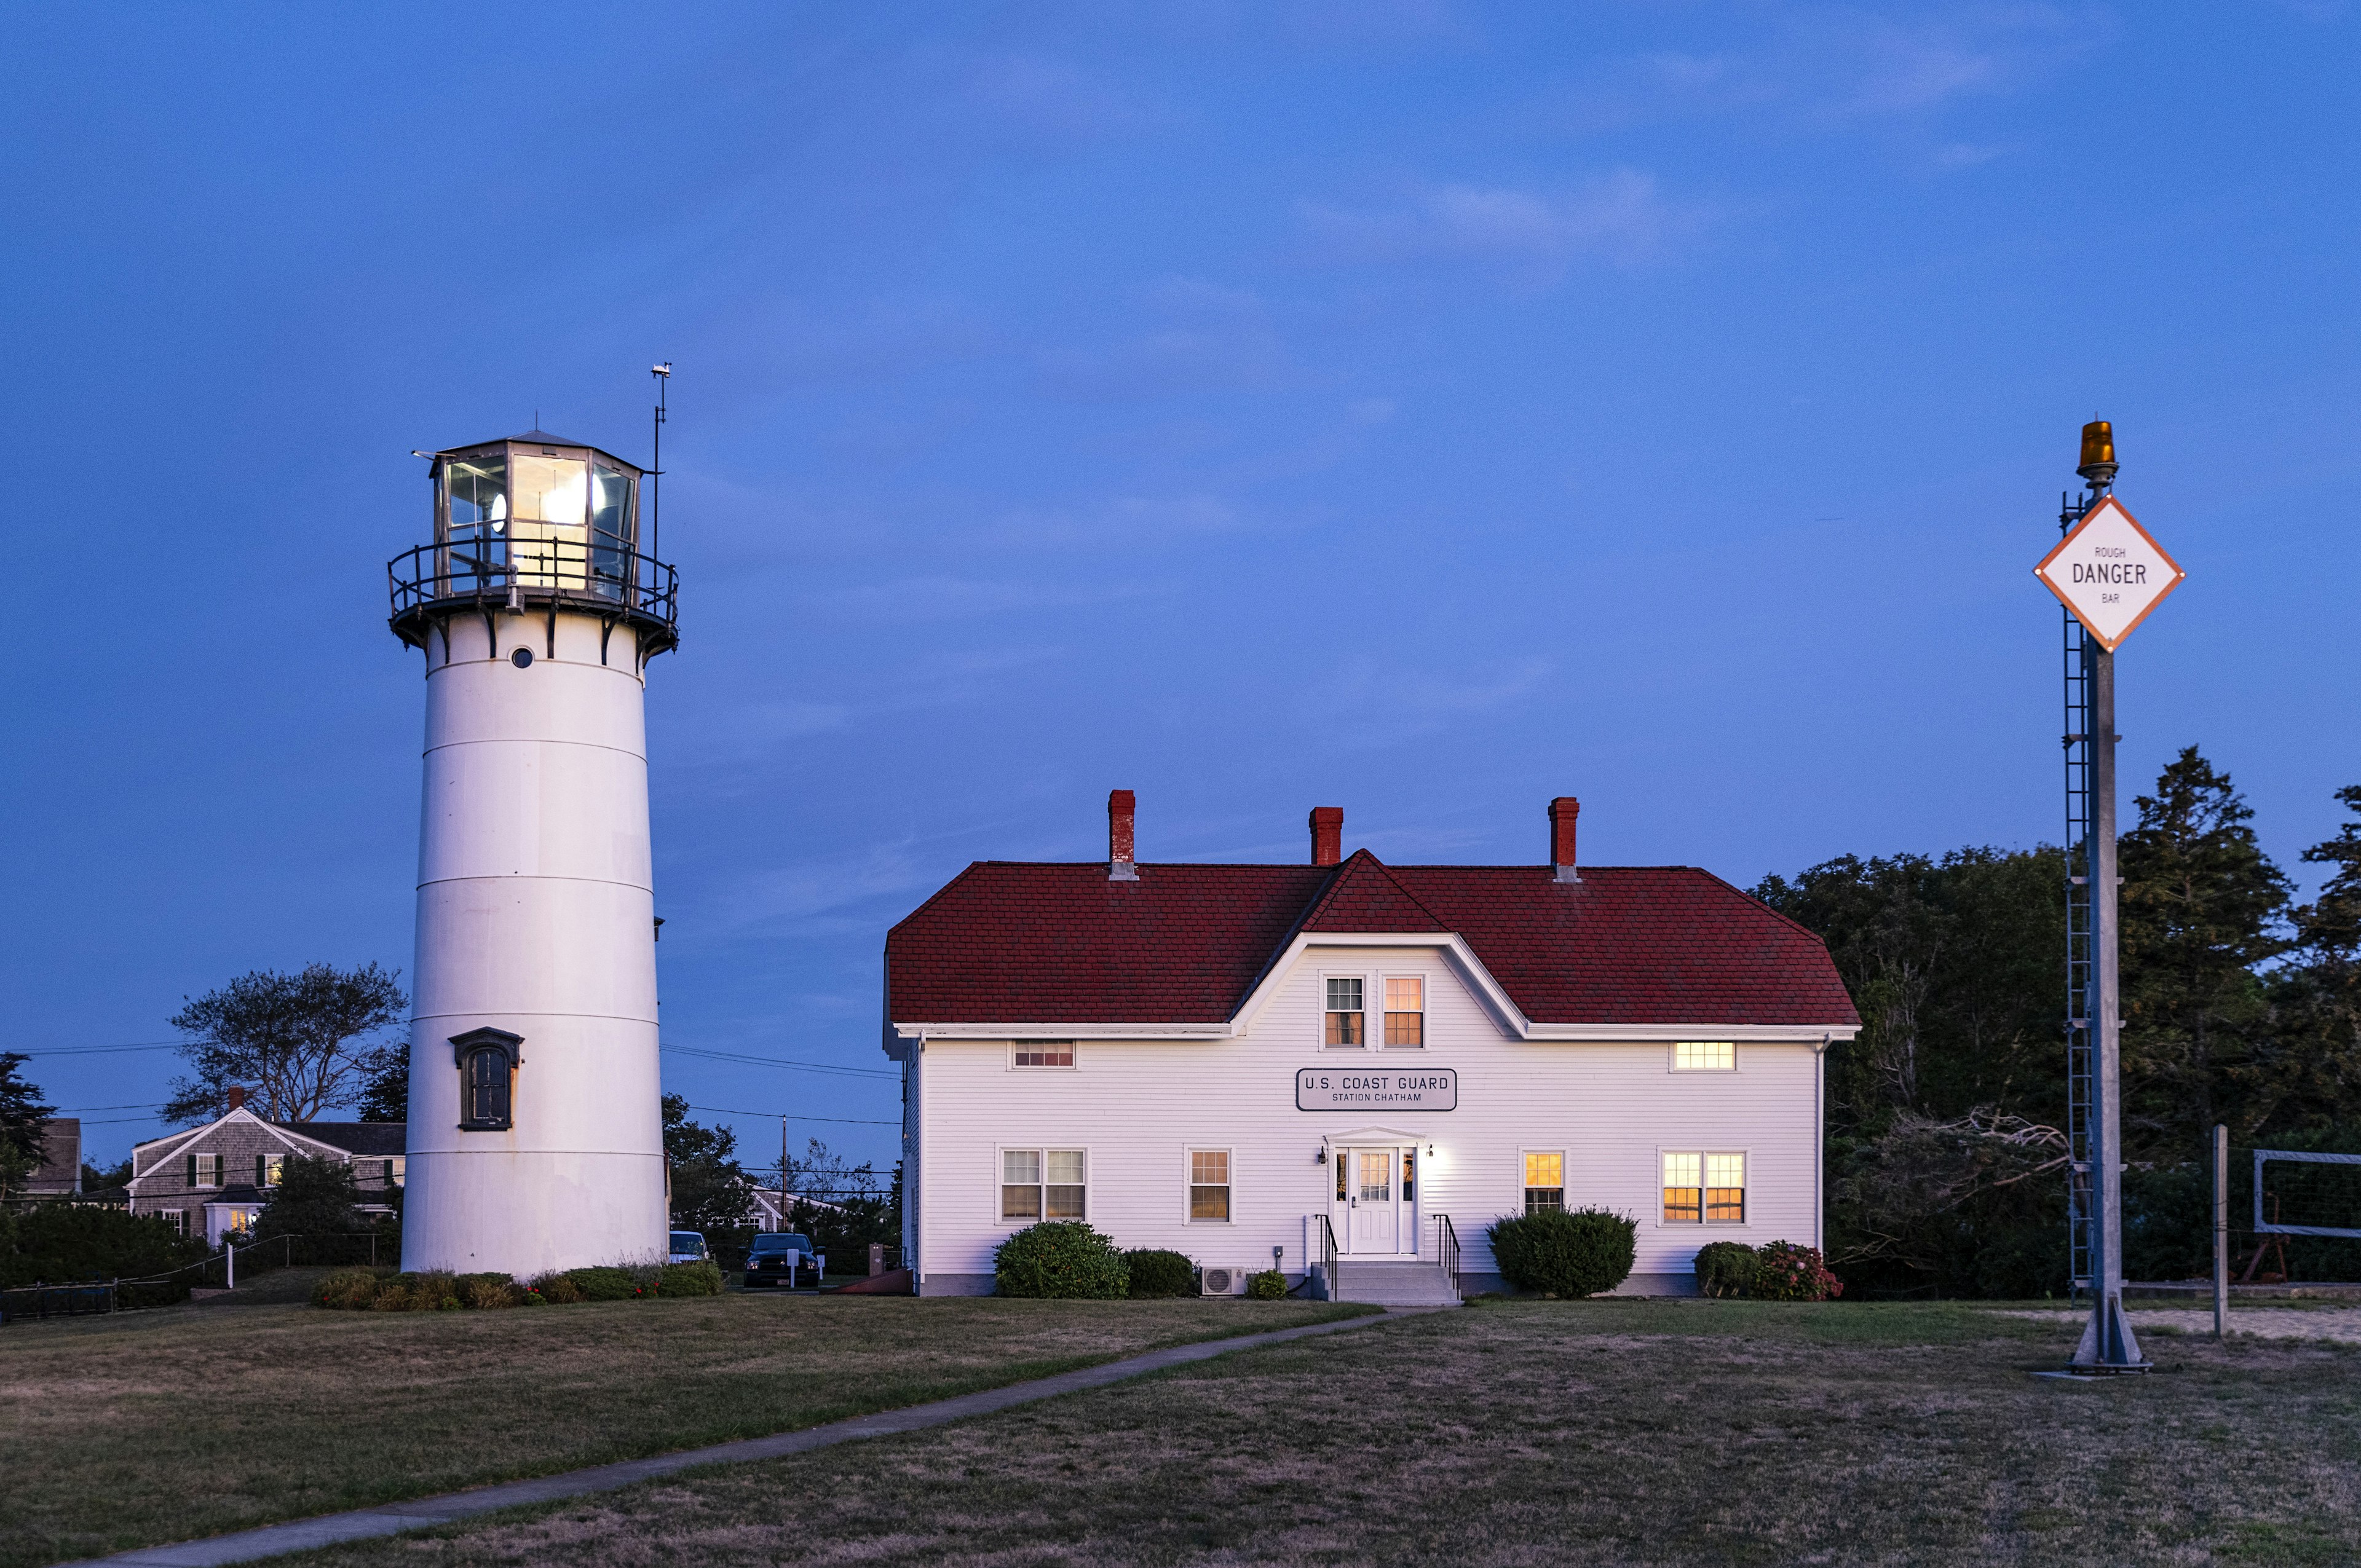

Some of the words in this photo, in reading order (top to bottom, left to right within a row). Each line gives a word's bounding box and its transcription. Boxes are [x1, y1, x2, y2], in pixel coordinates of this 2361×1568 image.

[2095, 547, 2126, 558] ROUGH
[2073, 564, 2146, 584] DANGER
[2102, 593, 2120, 603] BAR
[1305, 1077, 1334, 1089] U.S.
[1342, 1077, 1389, 1089] COAST
[1398, 1077, 1448, 1089] GUARD
